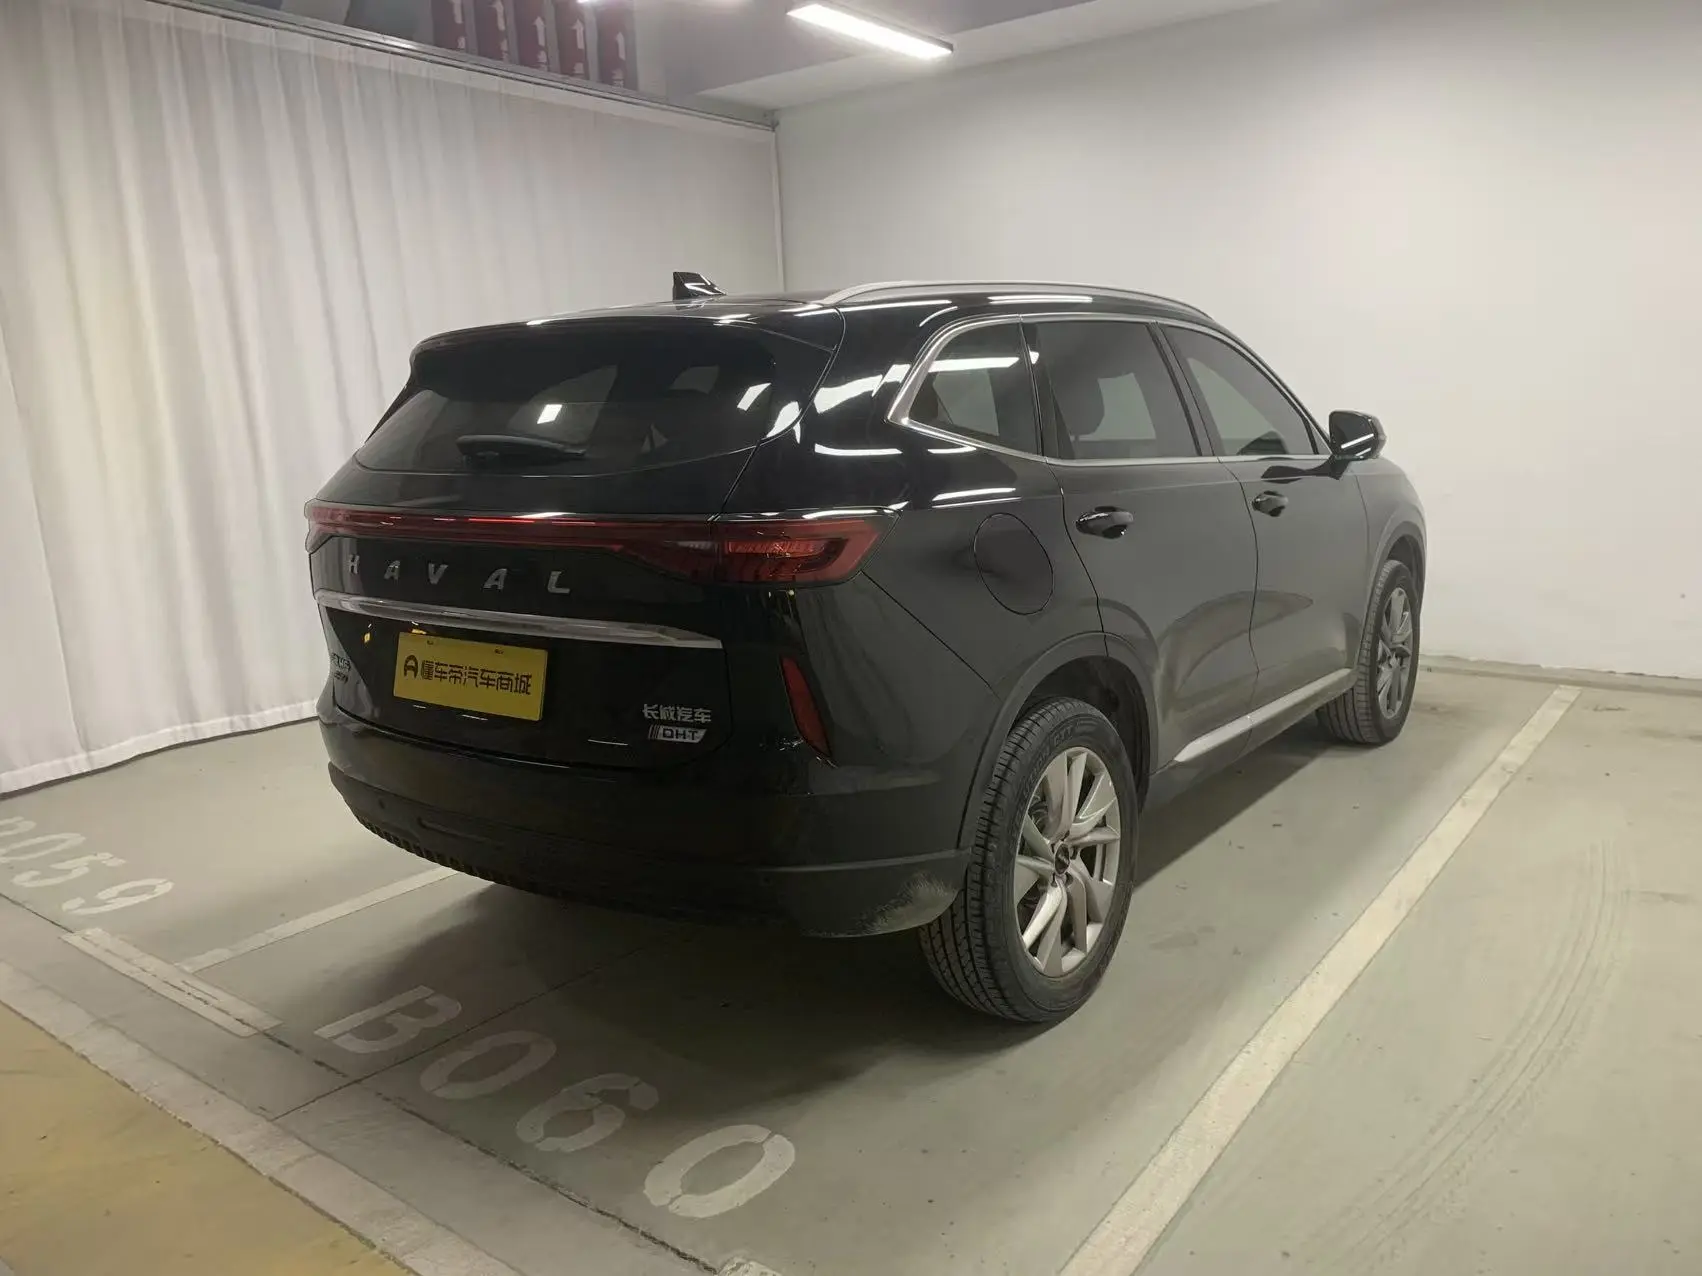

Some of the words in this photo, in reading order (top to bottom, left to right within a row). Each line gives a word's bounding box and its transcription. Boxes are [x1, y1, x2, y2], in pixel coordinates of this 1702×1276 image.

[344, 553, 571, 595] HAVAL
[641, 703, 713, 724] 长城汽车
[313, 984, 797, 1219] B060
